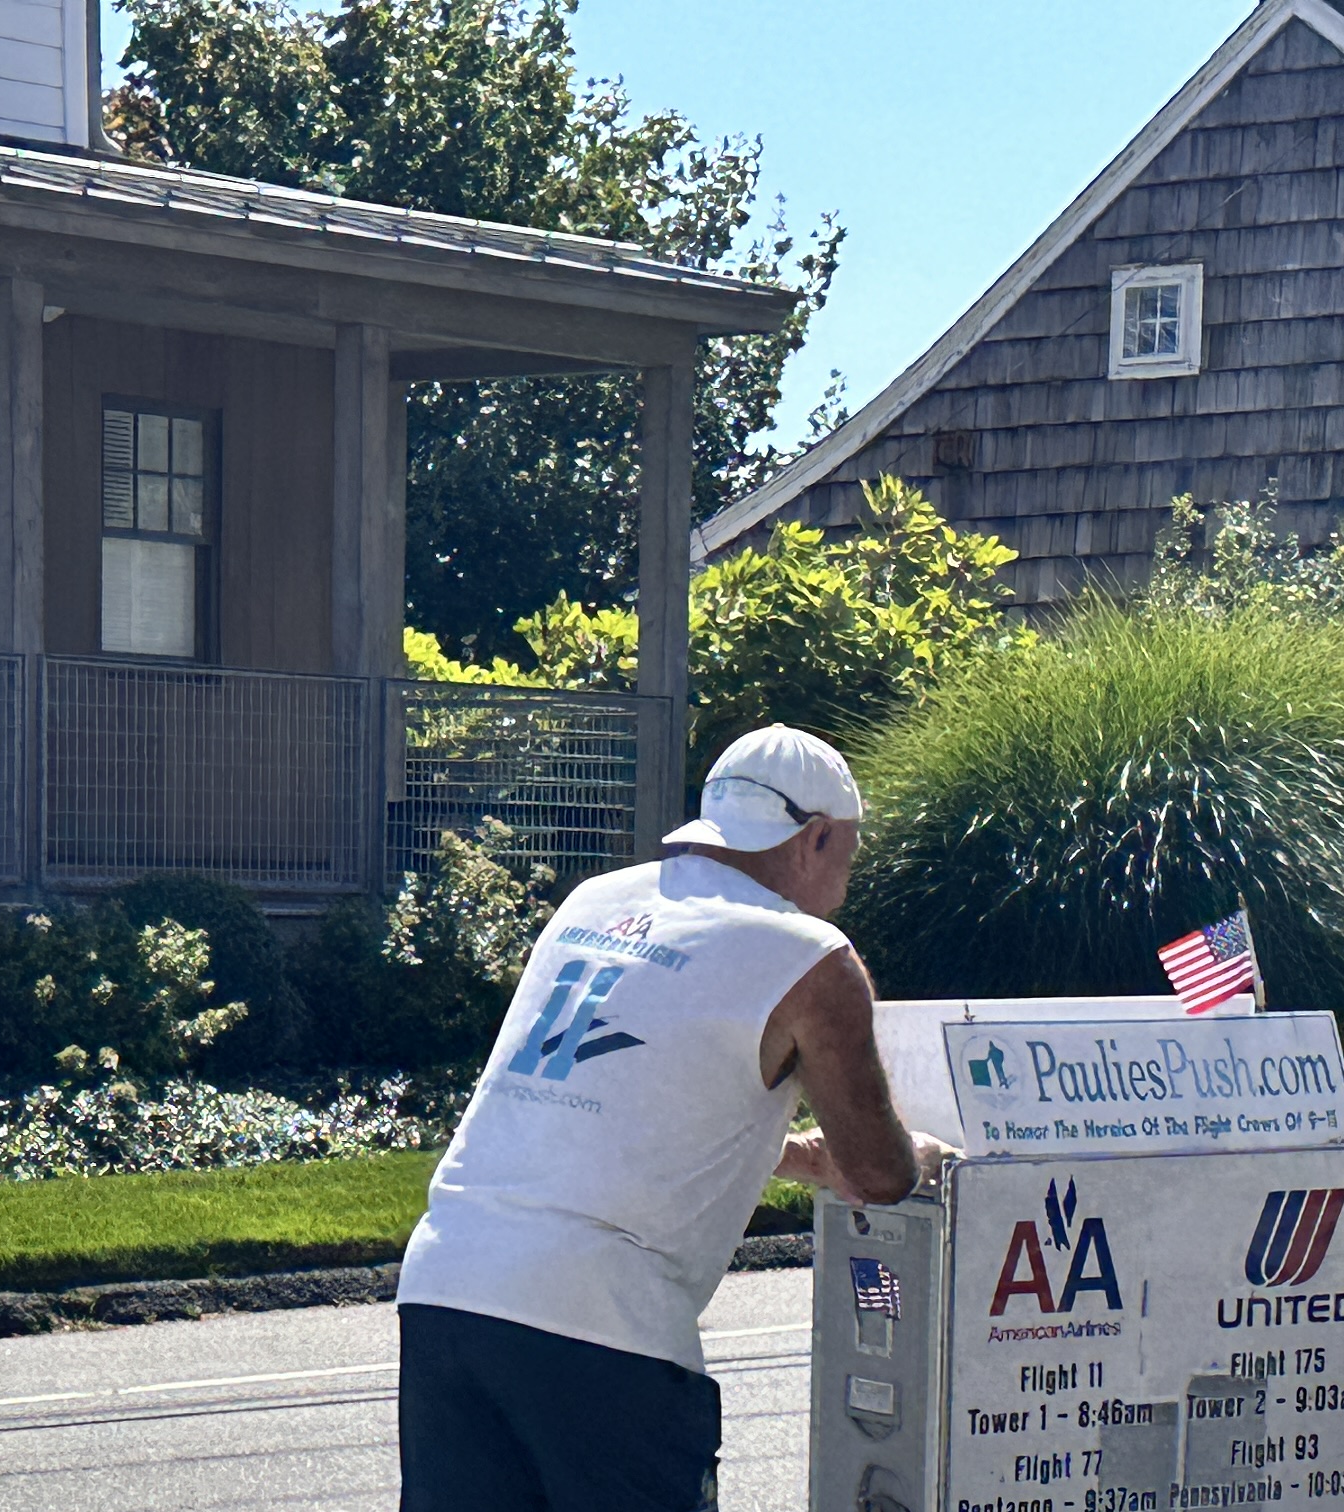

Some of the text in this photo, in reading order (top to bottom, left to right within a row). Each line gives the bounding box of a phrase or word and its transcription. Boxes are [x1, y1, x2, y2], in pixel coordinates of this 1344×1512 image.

[1025, 1038, 1337, 1102] PauliesPush.com
[982, 1121, 1000, 1140] To
[1005, 1120, 1049, 1140] Honor
[1054, 1119, 1079, 1139] The
[1141, 1116, 1160, 1136] Of
[1164, 1116, 1189, 1136] The
[1194, 1114, 1232, 1139] Flight
[1237, 1113, 1281, 1133] Crews
[1285, 1112, 1303, 1131] Of
[988, 1217, 1124, 1317] AA
[1020, 1361, 1103, 1395] Flight 11
[1230, 1348, 1326, 1379] Flight 175
[968, 1408, 1029, 1435] Tower
[1039, 1404, 1047, 1431] 1
[1078, 1399, 1153, 1428] 8:46am
[1187, 1393, 1245, 1420] Tower
[1255, 1390, 1266, 1415] 2
[1015, 1450, 1103, 1485] Flight 77
[1231, 1433, 1319, 1468] Flight 93
